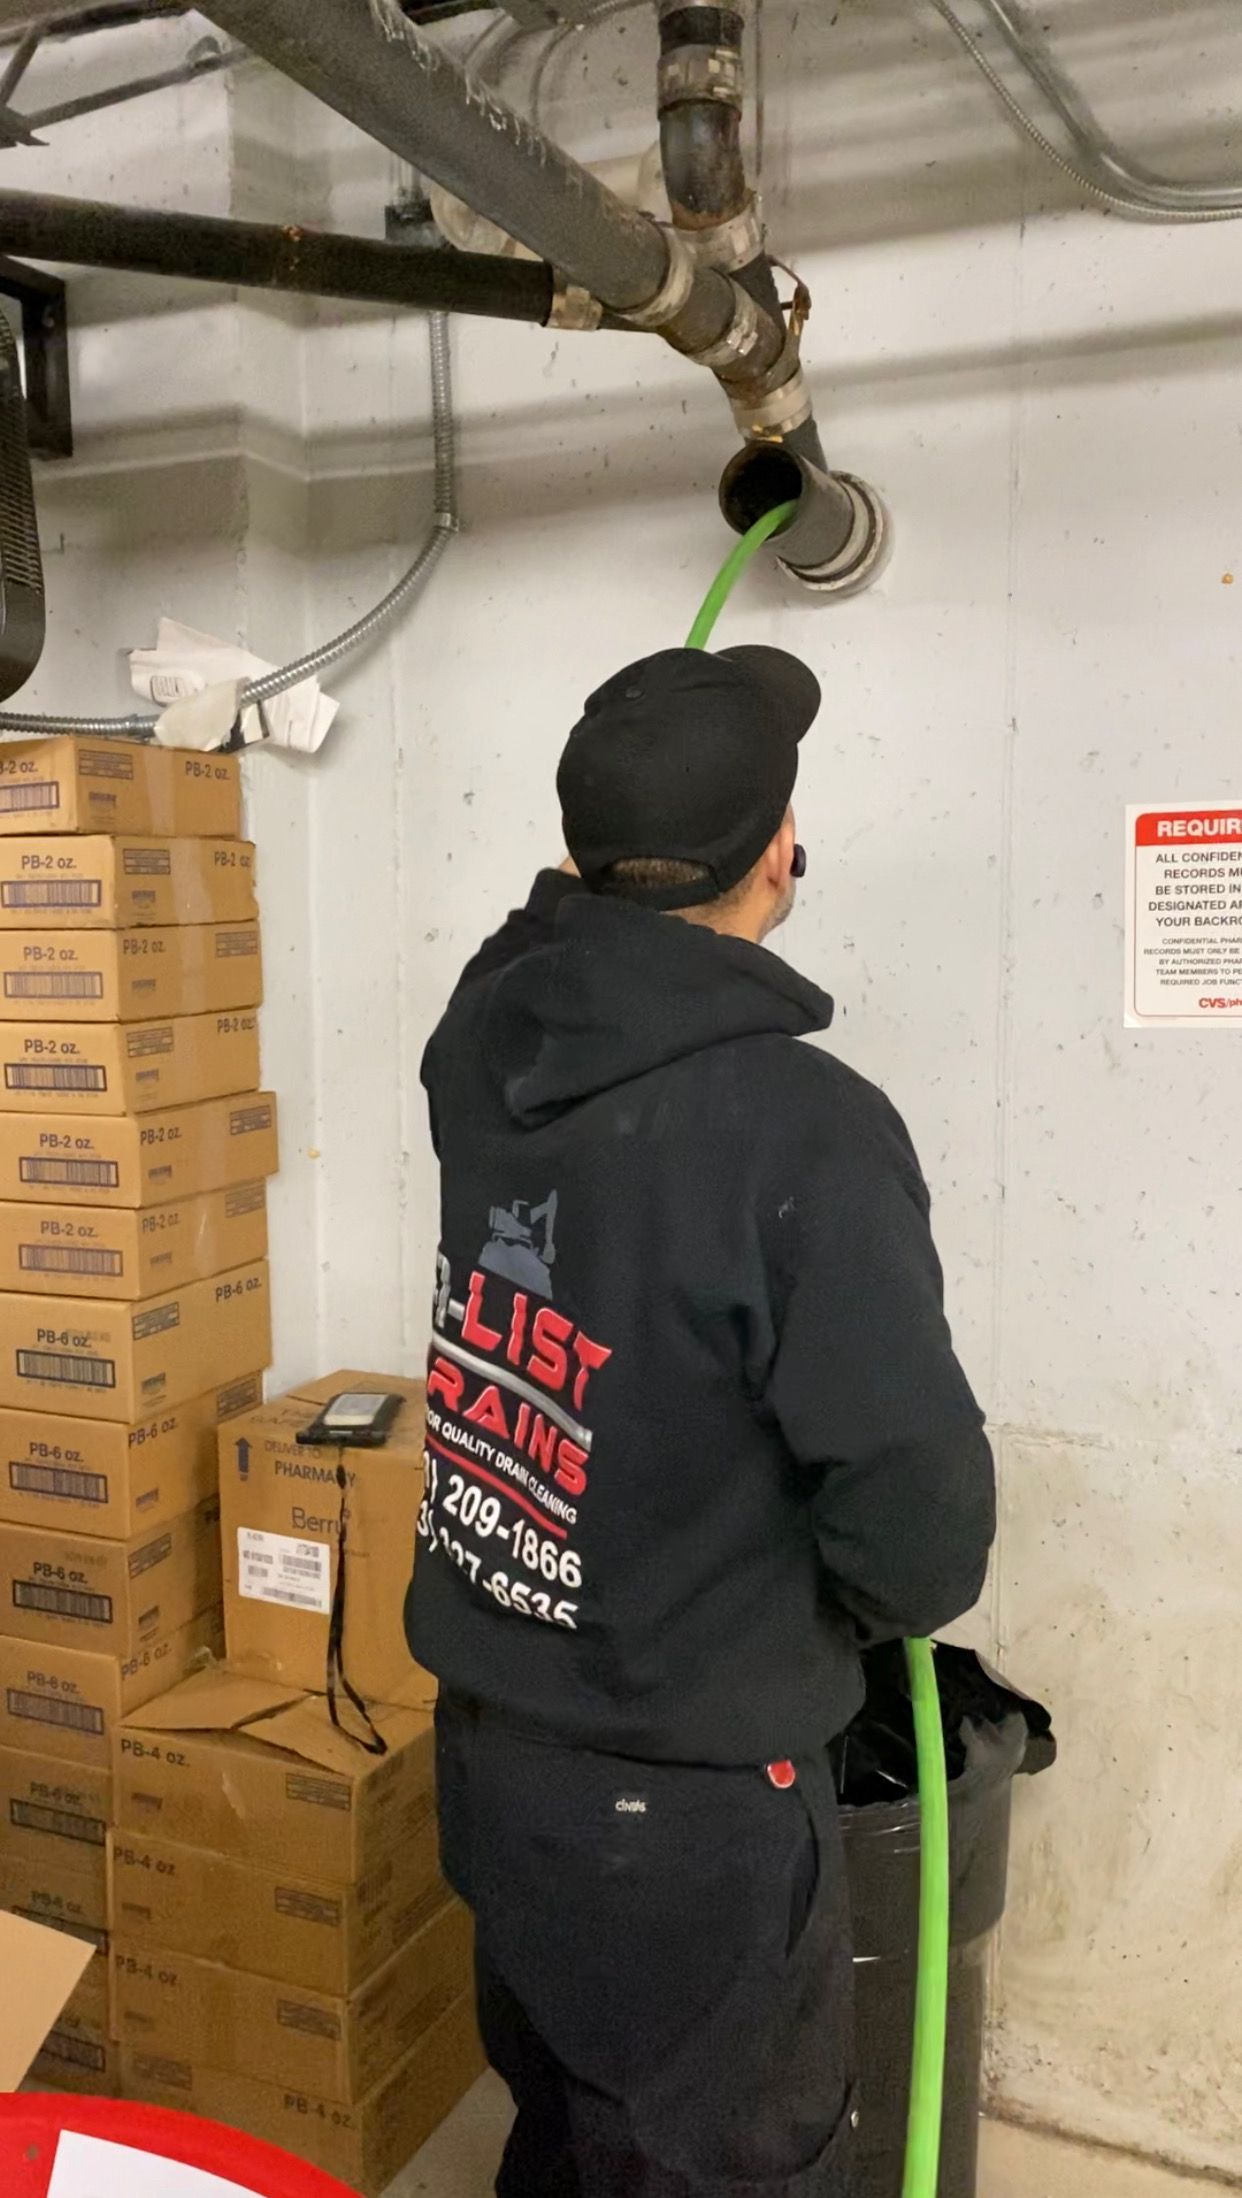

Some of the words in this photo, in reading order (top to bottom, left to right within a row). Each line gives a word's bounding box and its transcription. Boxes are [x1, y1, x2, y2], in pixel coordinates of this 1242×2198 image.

[185, 761, 211, 778] PB-2
[21, 855, 53, 870] PB-2
[57, 857, 77, 870] oz.
[214, 851, 236, 867] PB-2
[1155, 853, 1178, 863] ALL
[1164, 868, 1225, 879] RECORDS
[1155, 886, 1171, 896] BE
[1174, 884, 1225, 895] STORED
[1229, 883, 1241, 894] IN
[1148, 900, 1226, 911] DESIGNATED
[1155, 917, 1191, 927] YOUR
[23, 946, 55, 961] PB-2
[59, 949, 78, 961] oz.
[123, 939, 148, 955] PB-2
[217, 1018, 239, 1033] PB-2
[24, 1039, 56, 1053] PB-2
[60, 1041, 80, 1054] oz.
[39, 1133, 72, 1149] PB-2
[75, 1137, 95, 1150] oz.
[140, 1128, 165, 1146] PB-2
[40, 1221, 74, 1236] PB-2
[78, 1224, 98, 1238] oz.
[142, 1216, 166, 1233] PB-2
[215, 1281, 243, 1303] PB-6
[246, 1277, 262, 1292] oz.
[36, 1328, 69, 1345] PB-6
[72, 1333, 92, 1348] oz.
[428, 1356, 589, 1496] RAINS
[128, 1423, 158, 1449] PB-6
[29, 1442, 61, 1460] PB-6
[65, 1448, 84, 1463] oz.
[275, 1460, 356, 1487] PHARMAY
[426, 1410, 442, 1432] OR
[442, 1425, 496, 1462] QUALITY
[495, 1452, 529, 1488] DRAIN
[528, 1476, 577, 1525] CLEANING
[442, 1474, 582, 1588] 209-1866
[33, 1562, 65, 1580] PB-6
[68, 1569, 89, 1584] oz.
[120, 1652, 151, 1681] PB-6
[26, 1670, 59, 1690] PB-6
[121, 1738, 161, 1760] PB-4
[166, 1751, 191, 1767] oz.
[113, 1847, 151, 1870] PB-4
[115, 1954, 153, 1980] PB-4
